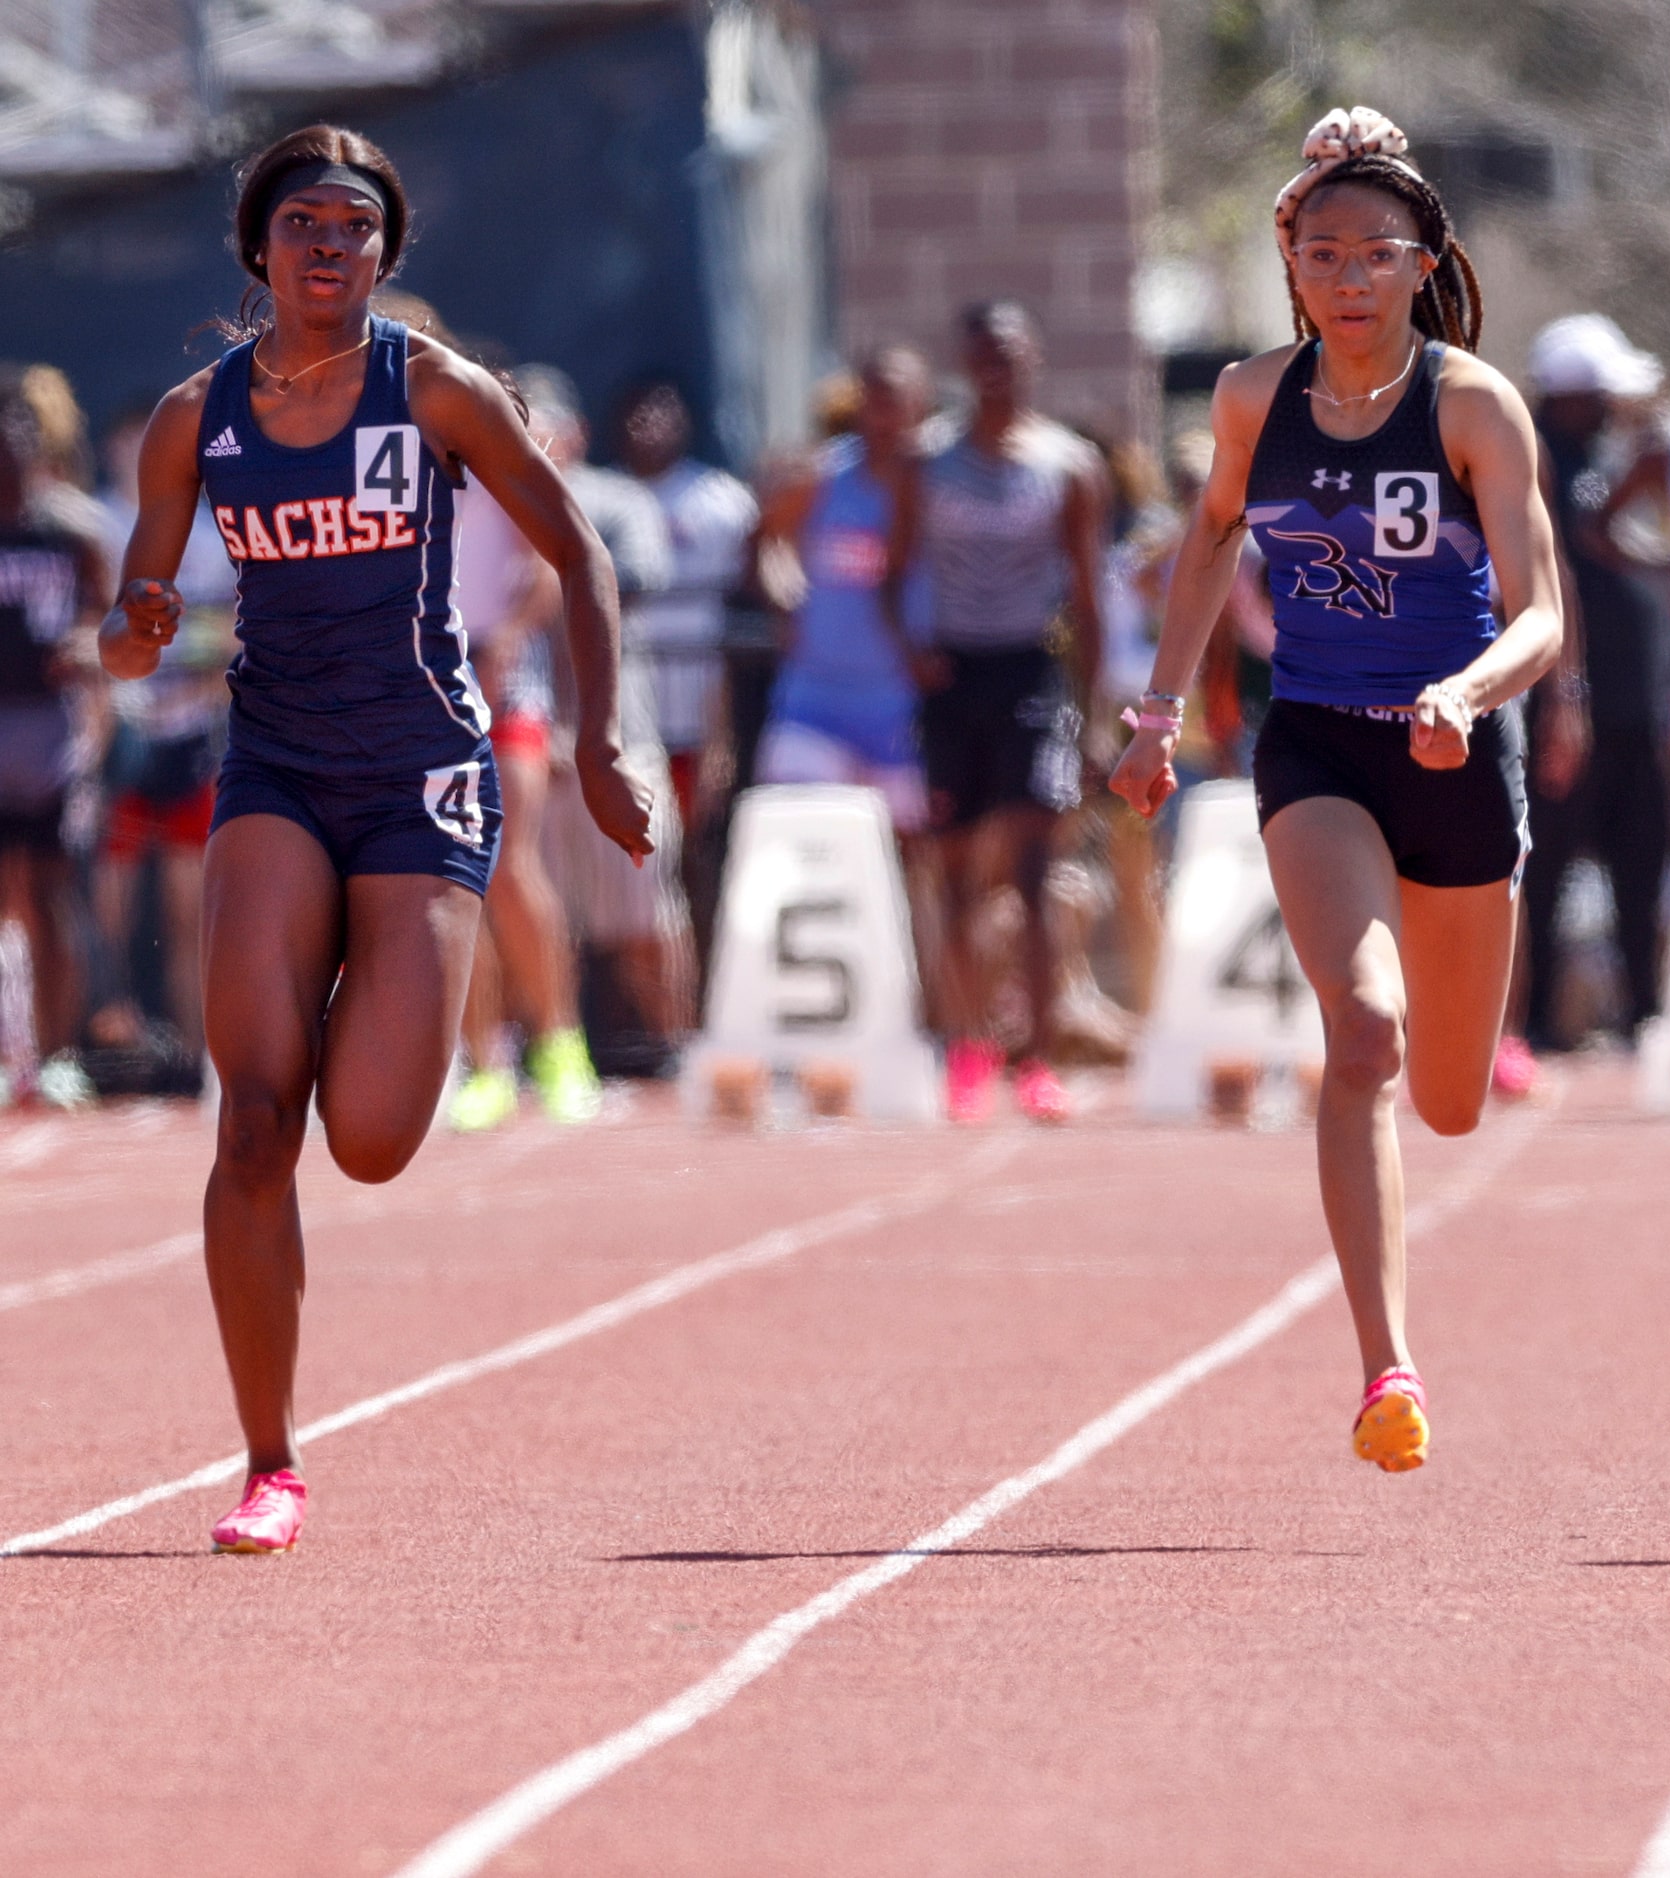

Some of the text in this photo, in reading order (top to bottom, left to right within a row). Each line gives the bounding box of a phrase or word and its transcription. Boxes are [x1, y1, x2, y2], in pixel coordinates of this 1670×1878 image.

[204, 445, 242, 457] adidas
[364, 431, 410, 505] 4
[215, 494, 417, 562] SACHSE
[1383, 477, 1428, 551] 3
[1267, 527, 1398, 619] BN
[436, 770, 475, 835] 4
[775, 899, 855, 1031] 5
[1216, 904, 1314, 1032] 4
